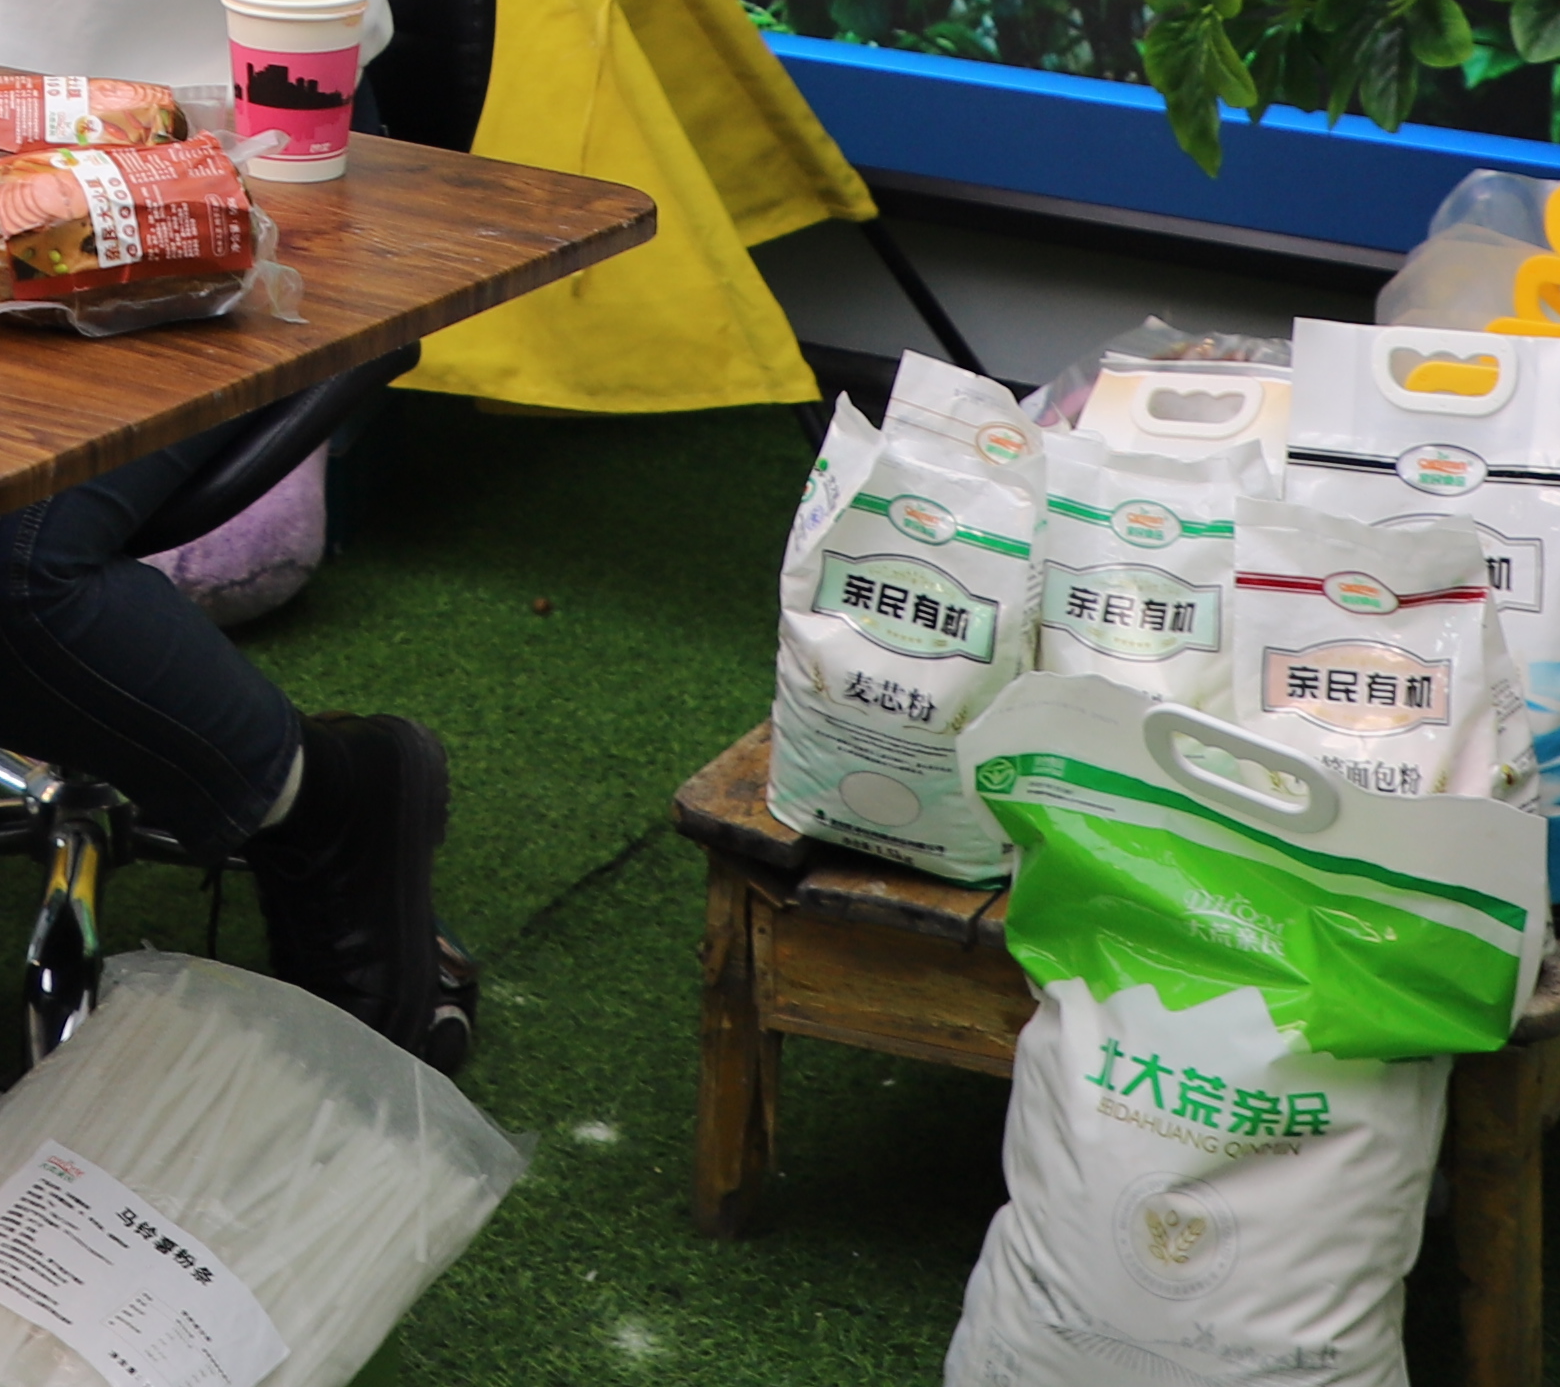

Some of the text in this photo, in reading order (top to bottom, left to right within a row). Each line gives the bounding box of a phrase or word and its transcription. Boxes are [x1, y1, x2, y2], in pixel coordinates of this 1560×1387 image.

[842, 573, 972, 643] 亲民有机
[1065, 585, 1198, 634] 亲民有机
[845, 671, 939, 723] 麦芯粉
[1287, 665, 1434, 711] 亲民有机
[1318, 755, 1424, 796] 面包粉
[116, 1206, 215, 1287] 马铃薯粉条
